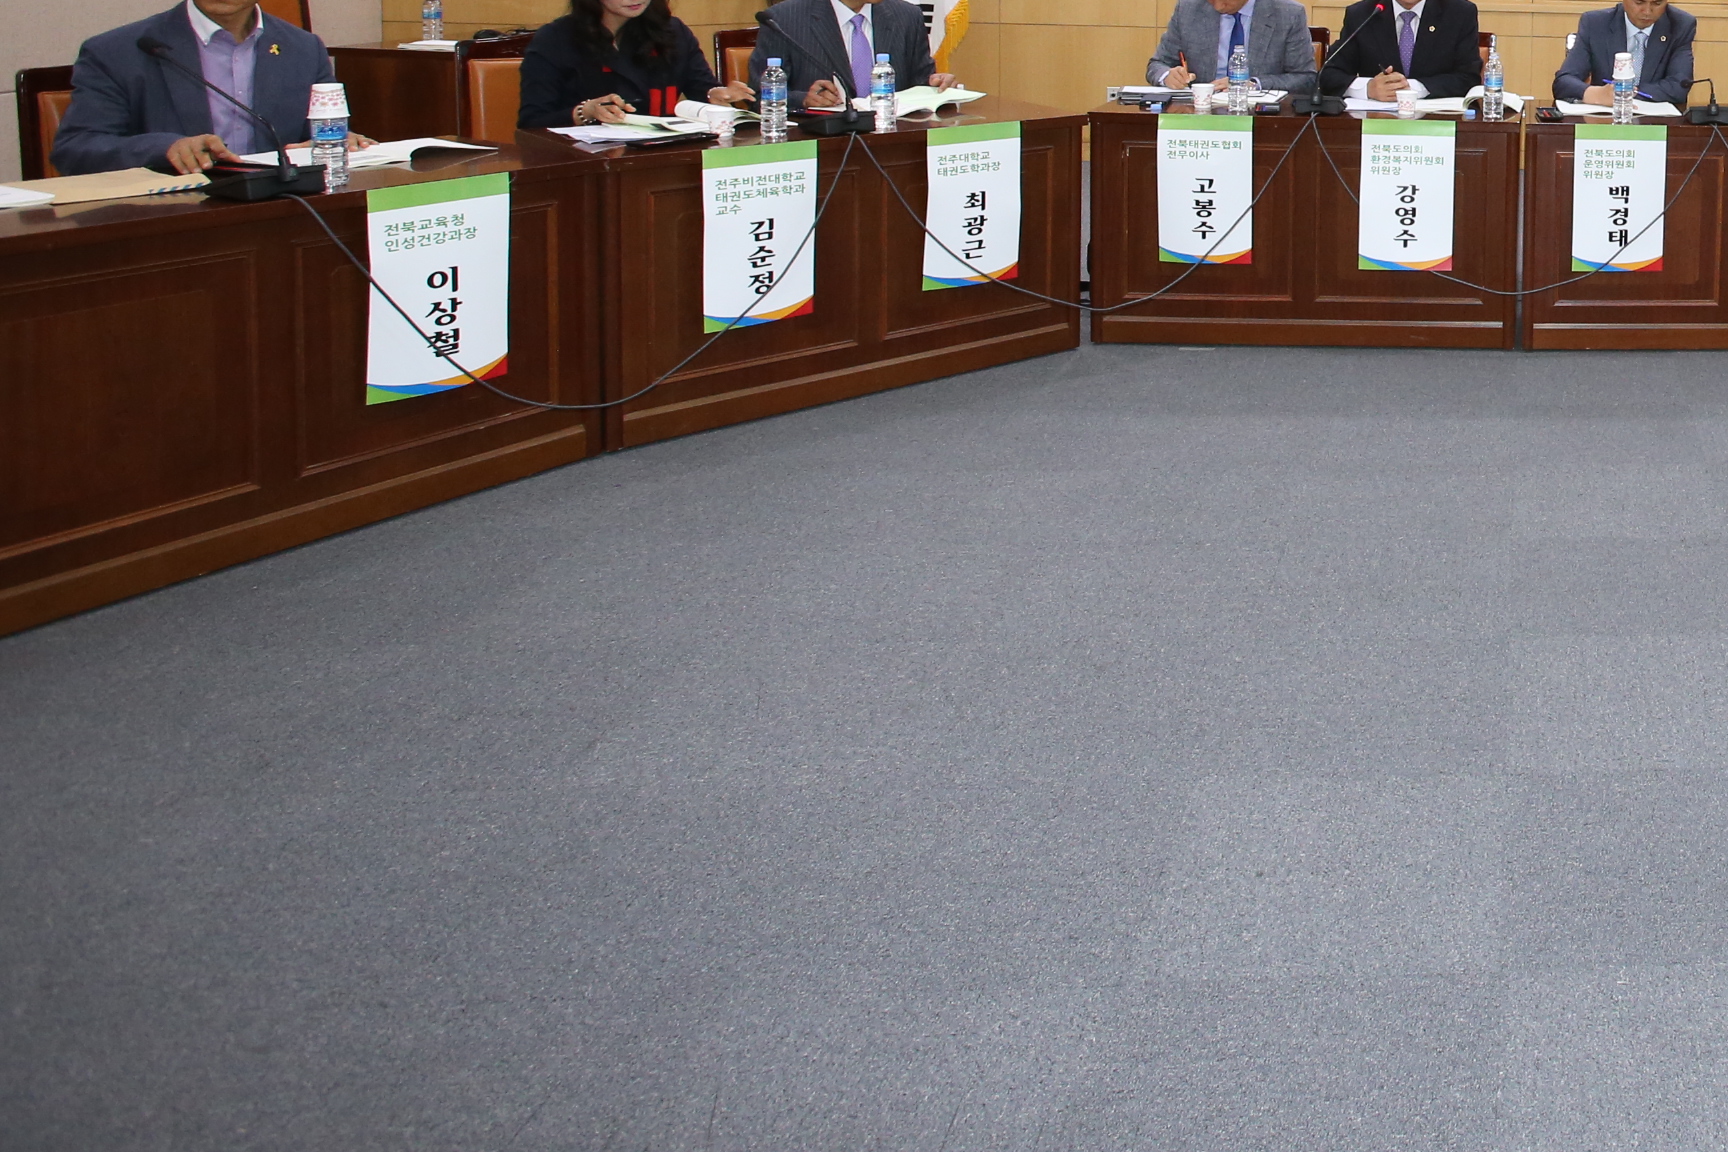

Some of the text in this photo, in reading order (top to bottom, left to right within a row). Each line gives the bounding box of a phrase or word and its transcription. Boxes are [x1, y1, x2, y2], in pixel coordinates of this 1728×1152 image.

[1166, 139, 1242, 150] 전북태권도협회
[1371, 144, 1423, 155] 전북도의회
[937, 151, 991, 166] 전주대학교
[1166, 150, 1210, 160] 전무이사
[1370, 154, 1445, 166] 환경복지위원회
[1583, 149, 1636, 159] 전북도의회
[937, 161, 1001, 177] 태권도학과장
[1370, 165, 1402, 176] 위원장
[1583, 159, 1635, 170] 운영위원회
[714, 170, 806, 191] 전주비전대학교
[1583, 169, 1615, 180] 위원장
[715, 183, 806, 203] 태권도체육학과
[715, 203, 743, 217] 교수
[1191, 177, 1217, 240] 고봉수
[1393, 184, 1420, 248] 강영수
[1607, 185, 1630, 248] 백경태
[383, 213, 466, 238] 전북교육청
[961, 191, 988, 260] 최광근
[384, 226, 478, 253] 인성건강과장
[747, 217, 776, 296] 김순정
[425, 265, 463, 358] 이상철
